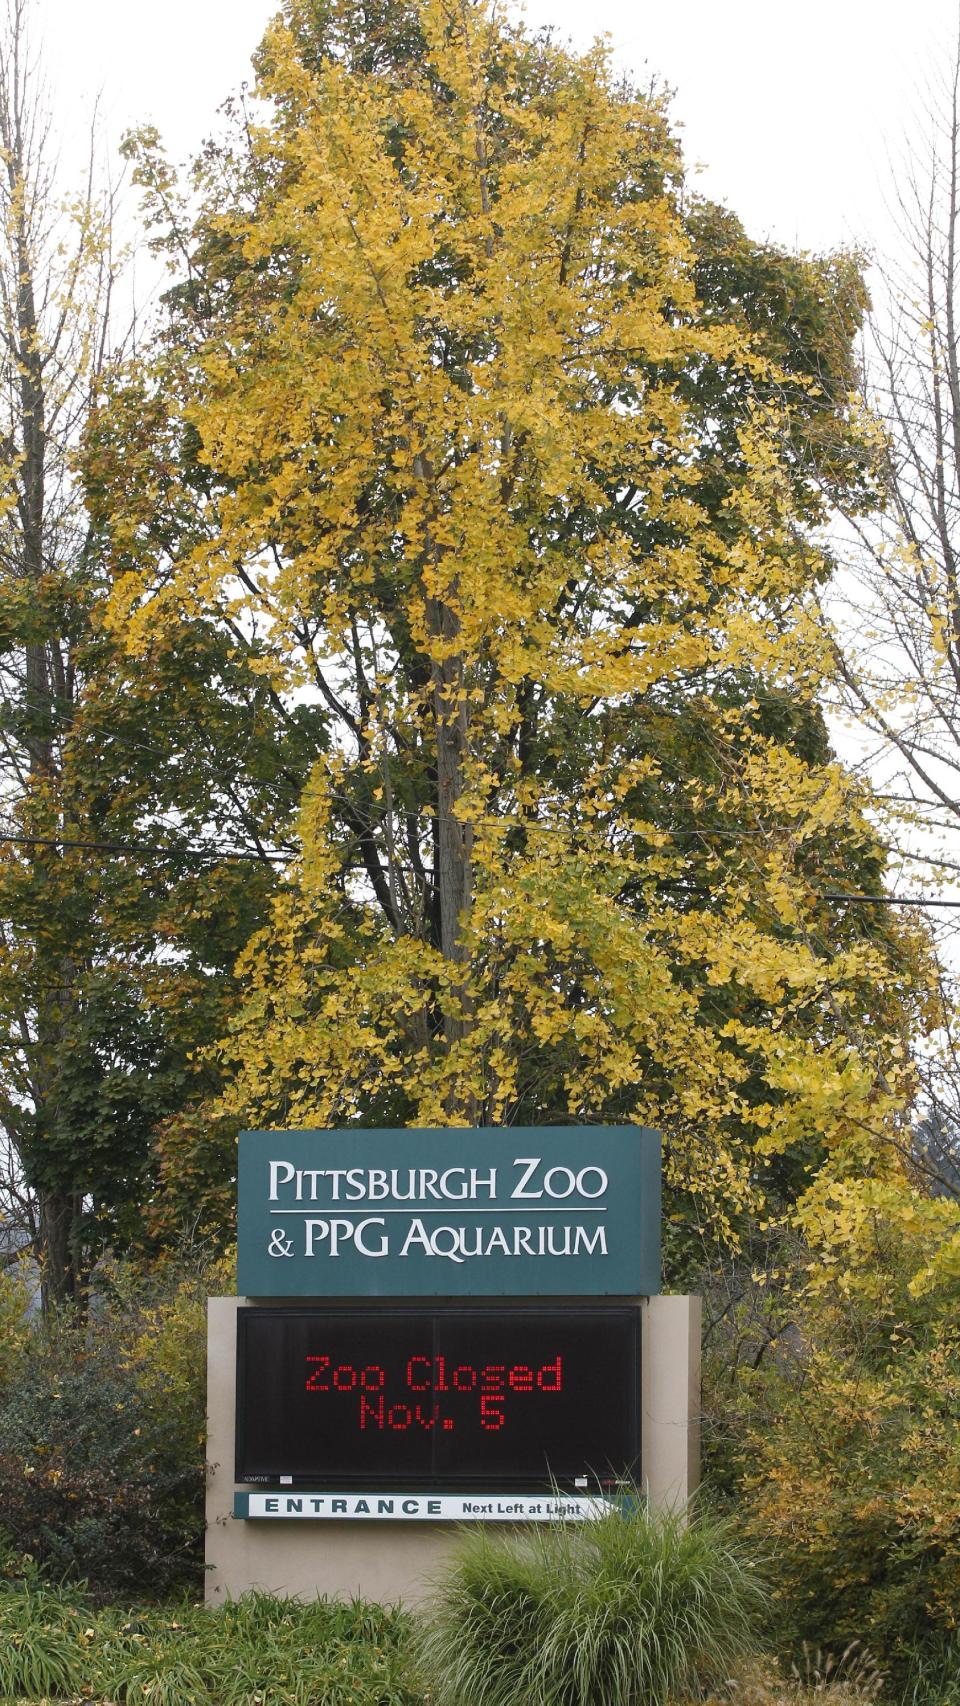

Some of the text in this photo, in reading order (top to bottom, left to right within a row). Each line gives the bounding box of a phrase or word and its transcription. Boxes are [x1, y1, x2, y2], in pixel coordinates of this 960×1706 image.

[268, 1157, 609, 1202] PITTSBURGH ZOO
[267, 1217, 609, 1263] & PPG AQUARIUM
[306, 1355, 563, 1392] Zoo Closed
[360, 1394, 505, 1430] Nov. 5
[265, 1498, 581, 1517] ENTRANCE Next Left at Light
